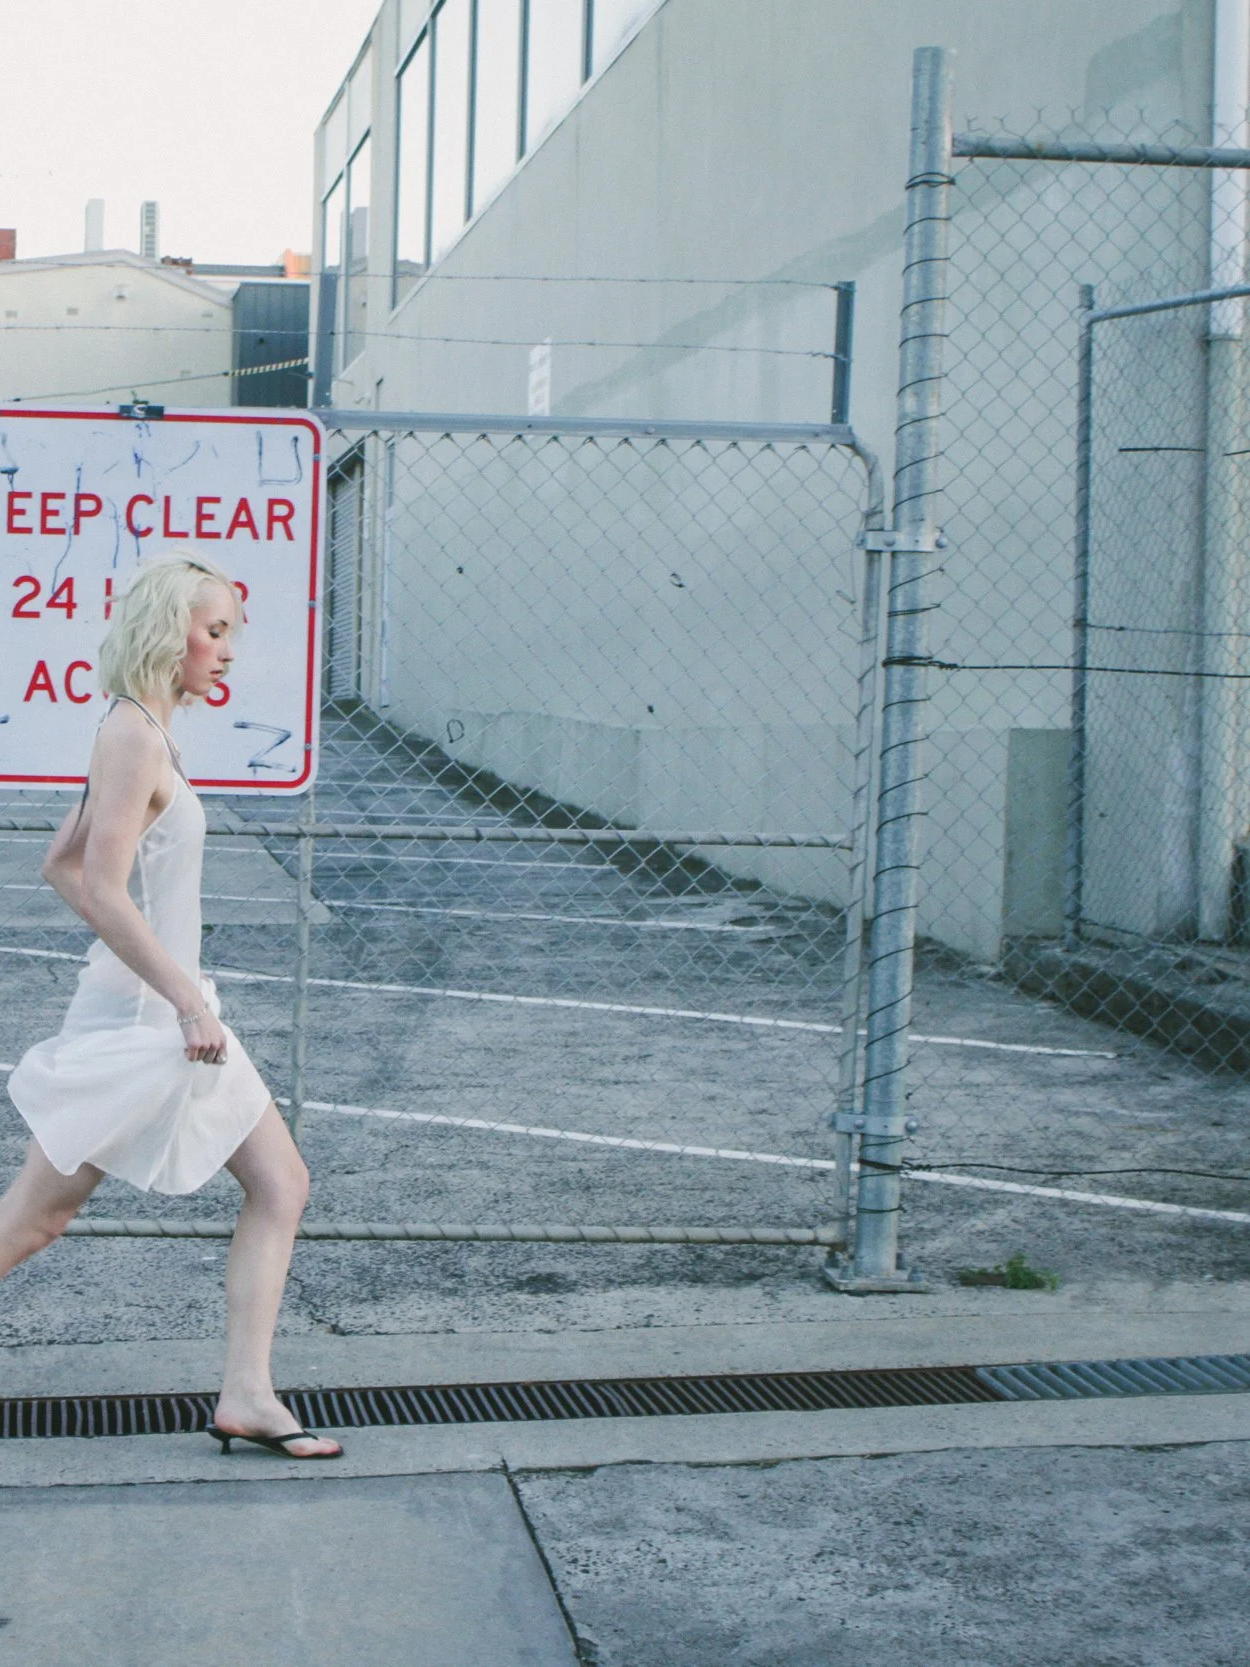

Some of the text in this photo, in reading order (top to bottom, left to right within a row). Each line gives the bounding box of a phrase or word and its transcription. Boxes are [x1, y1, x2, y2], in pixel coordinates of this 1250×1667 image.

[125, 494, 296, 542] CLEAR
[11, 575, 78, 620] 24
[23, 660, 231, 708] ACS
